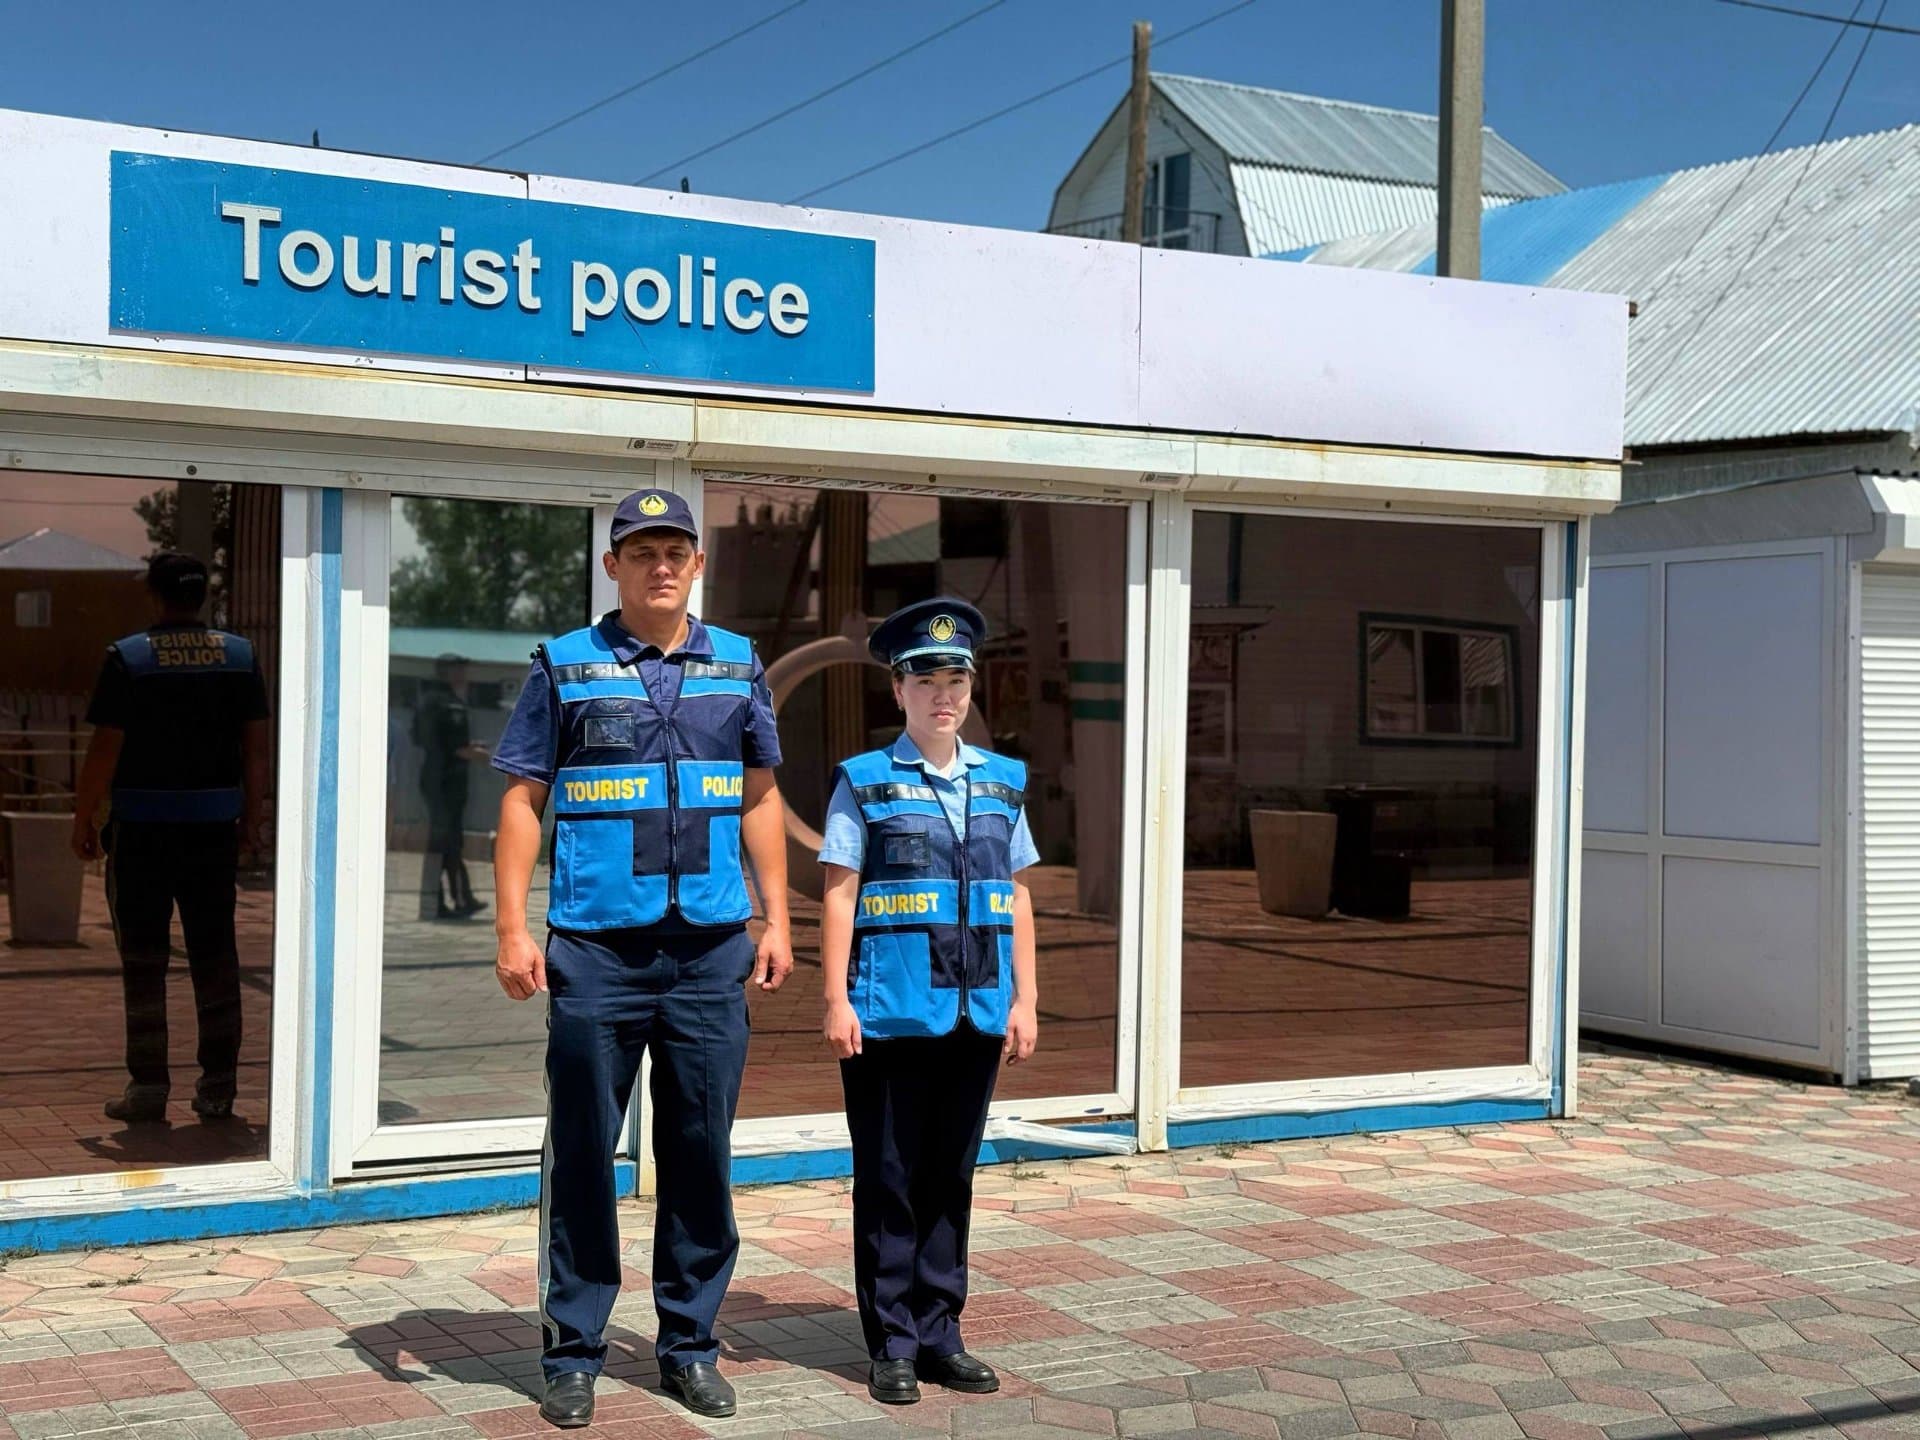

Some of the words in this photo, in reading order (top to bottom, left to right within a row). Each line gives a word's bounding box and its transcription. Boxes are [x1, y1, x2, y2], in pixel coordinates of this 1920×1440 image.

[222, 202, 540, 311] Tourist
[571, 254, 811, 334] police
[565, 777, 648, 802] TOURIST
[702, 775, 743, 797] POLIC
[863, 892, 939, 915] TOURIST
